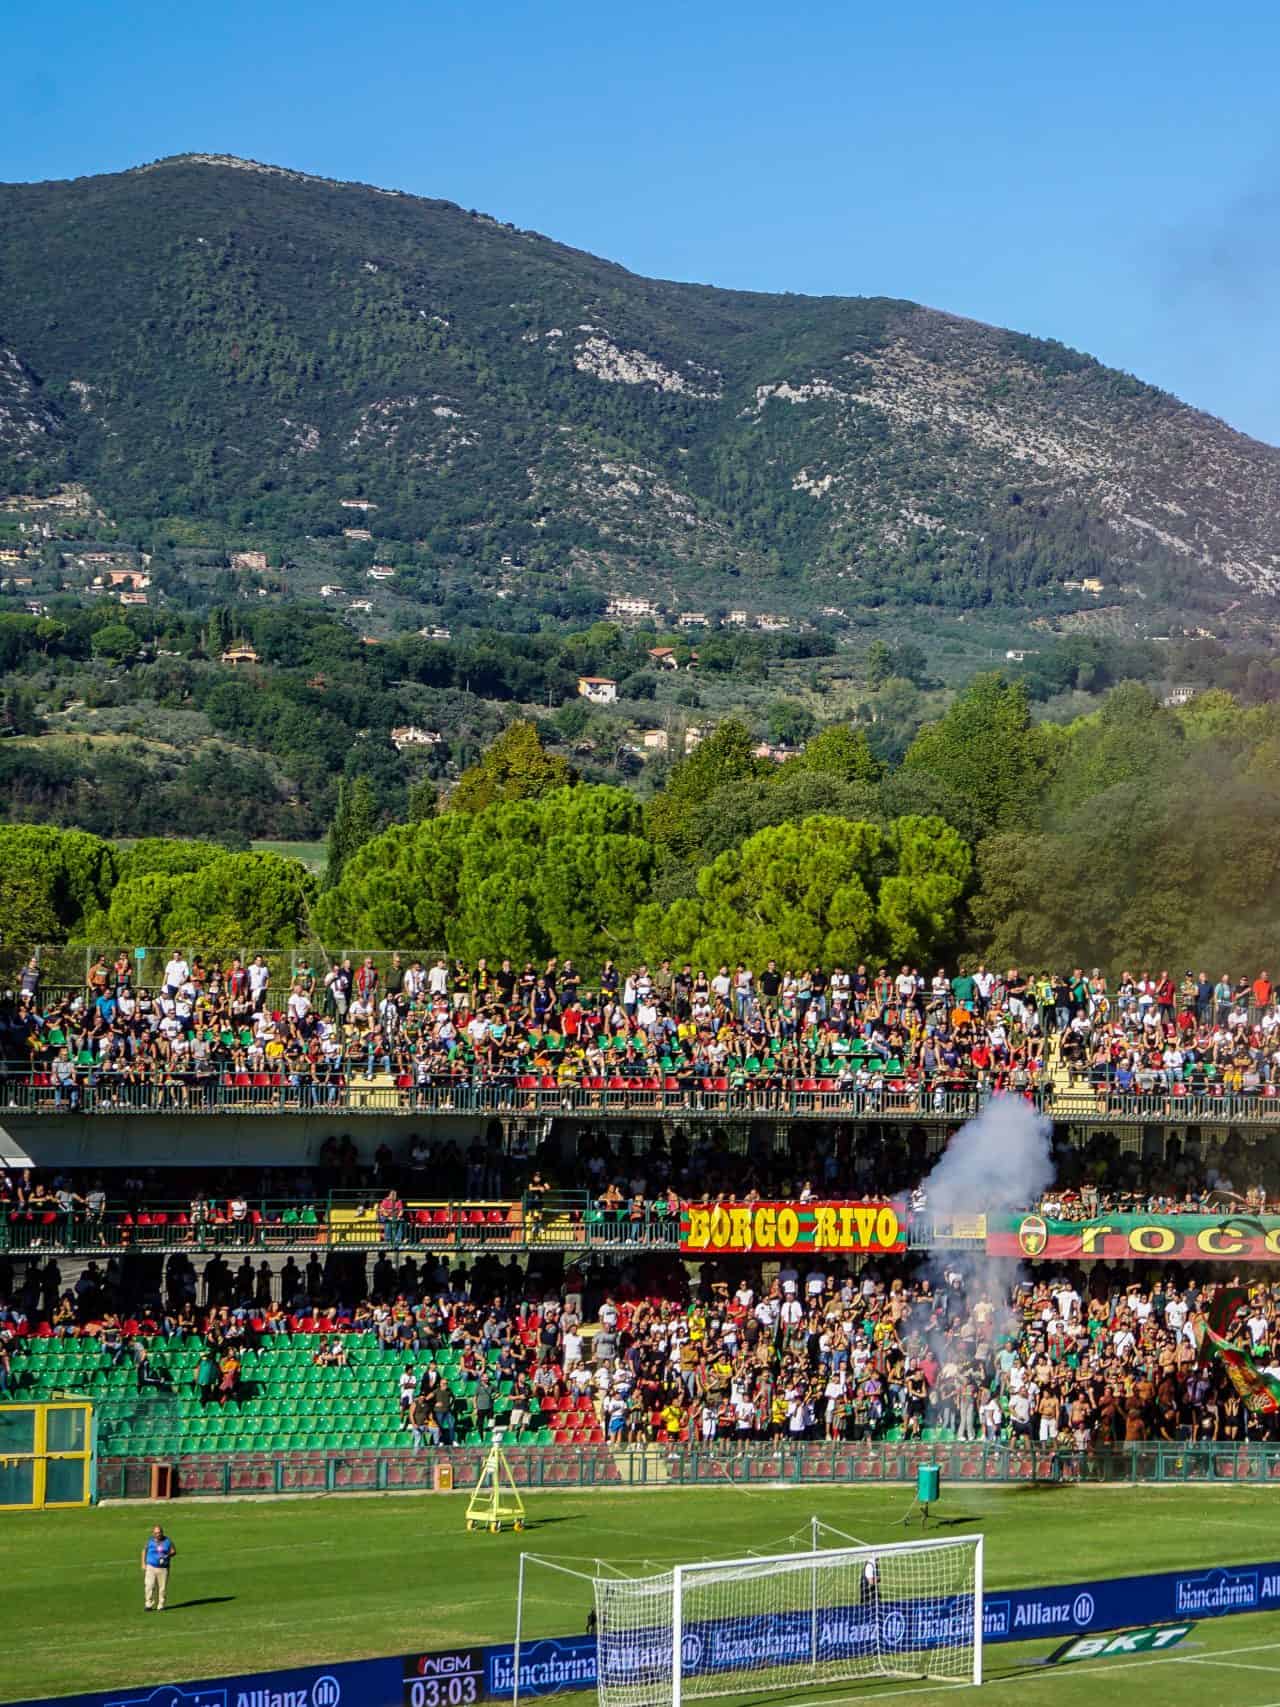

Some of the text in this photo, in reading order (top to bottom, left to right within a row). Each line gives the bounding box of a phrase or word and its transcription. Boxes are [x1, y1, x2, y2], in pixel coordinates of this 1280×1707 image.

[687, 1207, 900, 1248] BORGO RIVO
[1178, 1573, 1255, 1610] biancafarina
[1015, 1604, 1070, 1627] Allianz
[1066, 1627, 1188, 1658] BKT
[423, 1654, 472, 1675] NGM
[494, 1643, 598, 1690] biancafarina
[411, 1676, 477, 1707] 03:03
